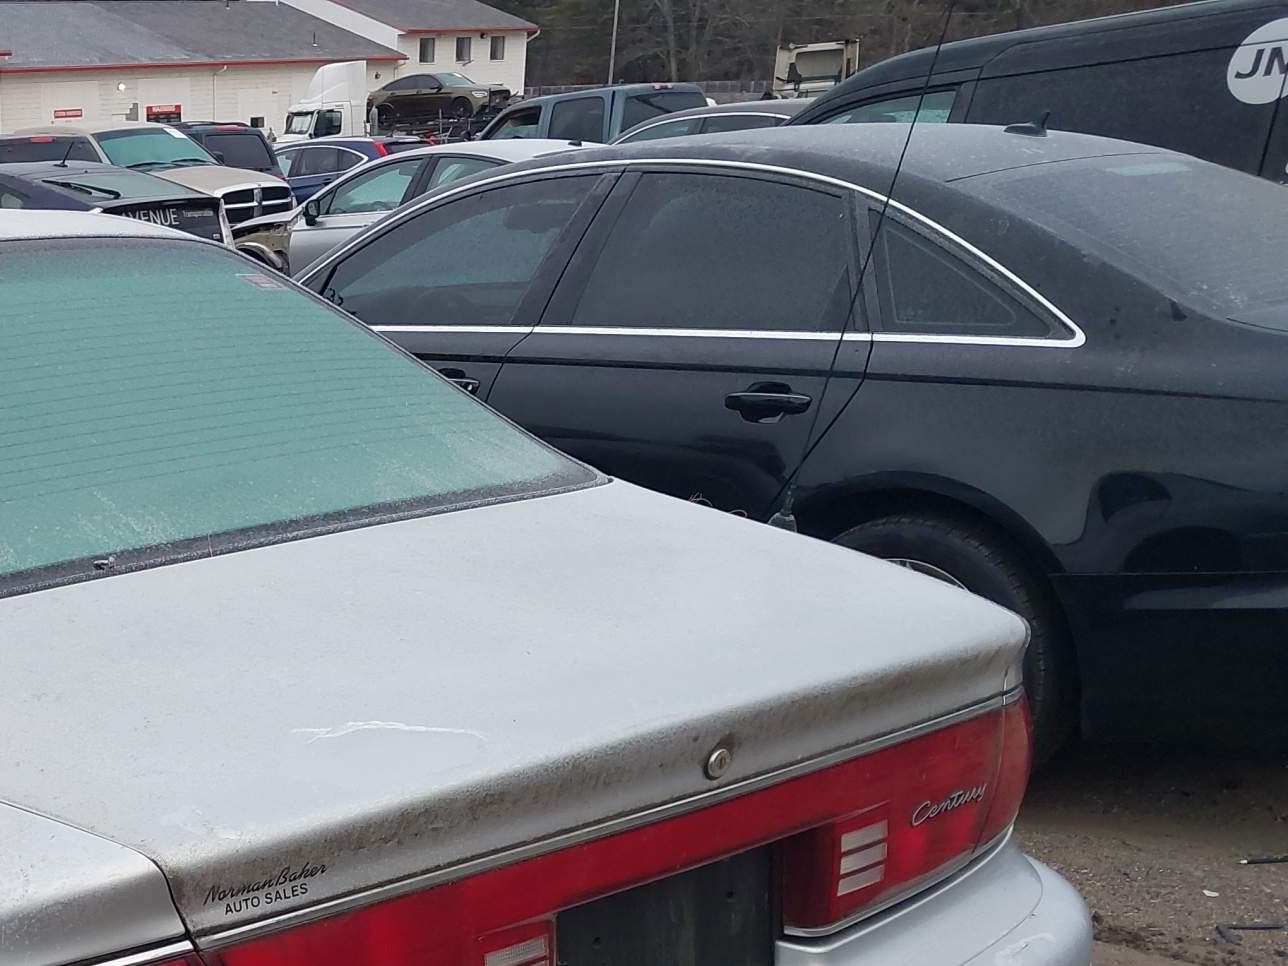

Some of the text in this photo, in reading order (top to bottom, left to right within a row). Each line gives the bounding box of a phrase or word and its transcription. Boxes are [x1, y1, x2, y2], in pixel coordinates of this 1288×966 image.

[912, 783, 987, 826] Century
[203, 861, 328, 906] Norman Baker
[224, 883, 309, 915] AUTO SALES
